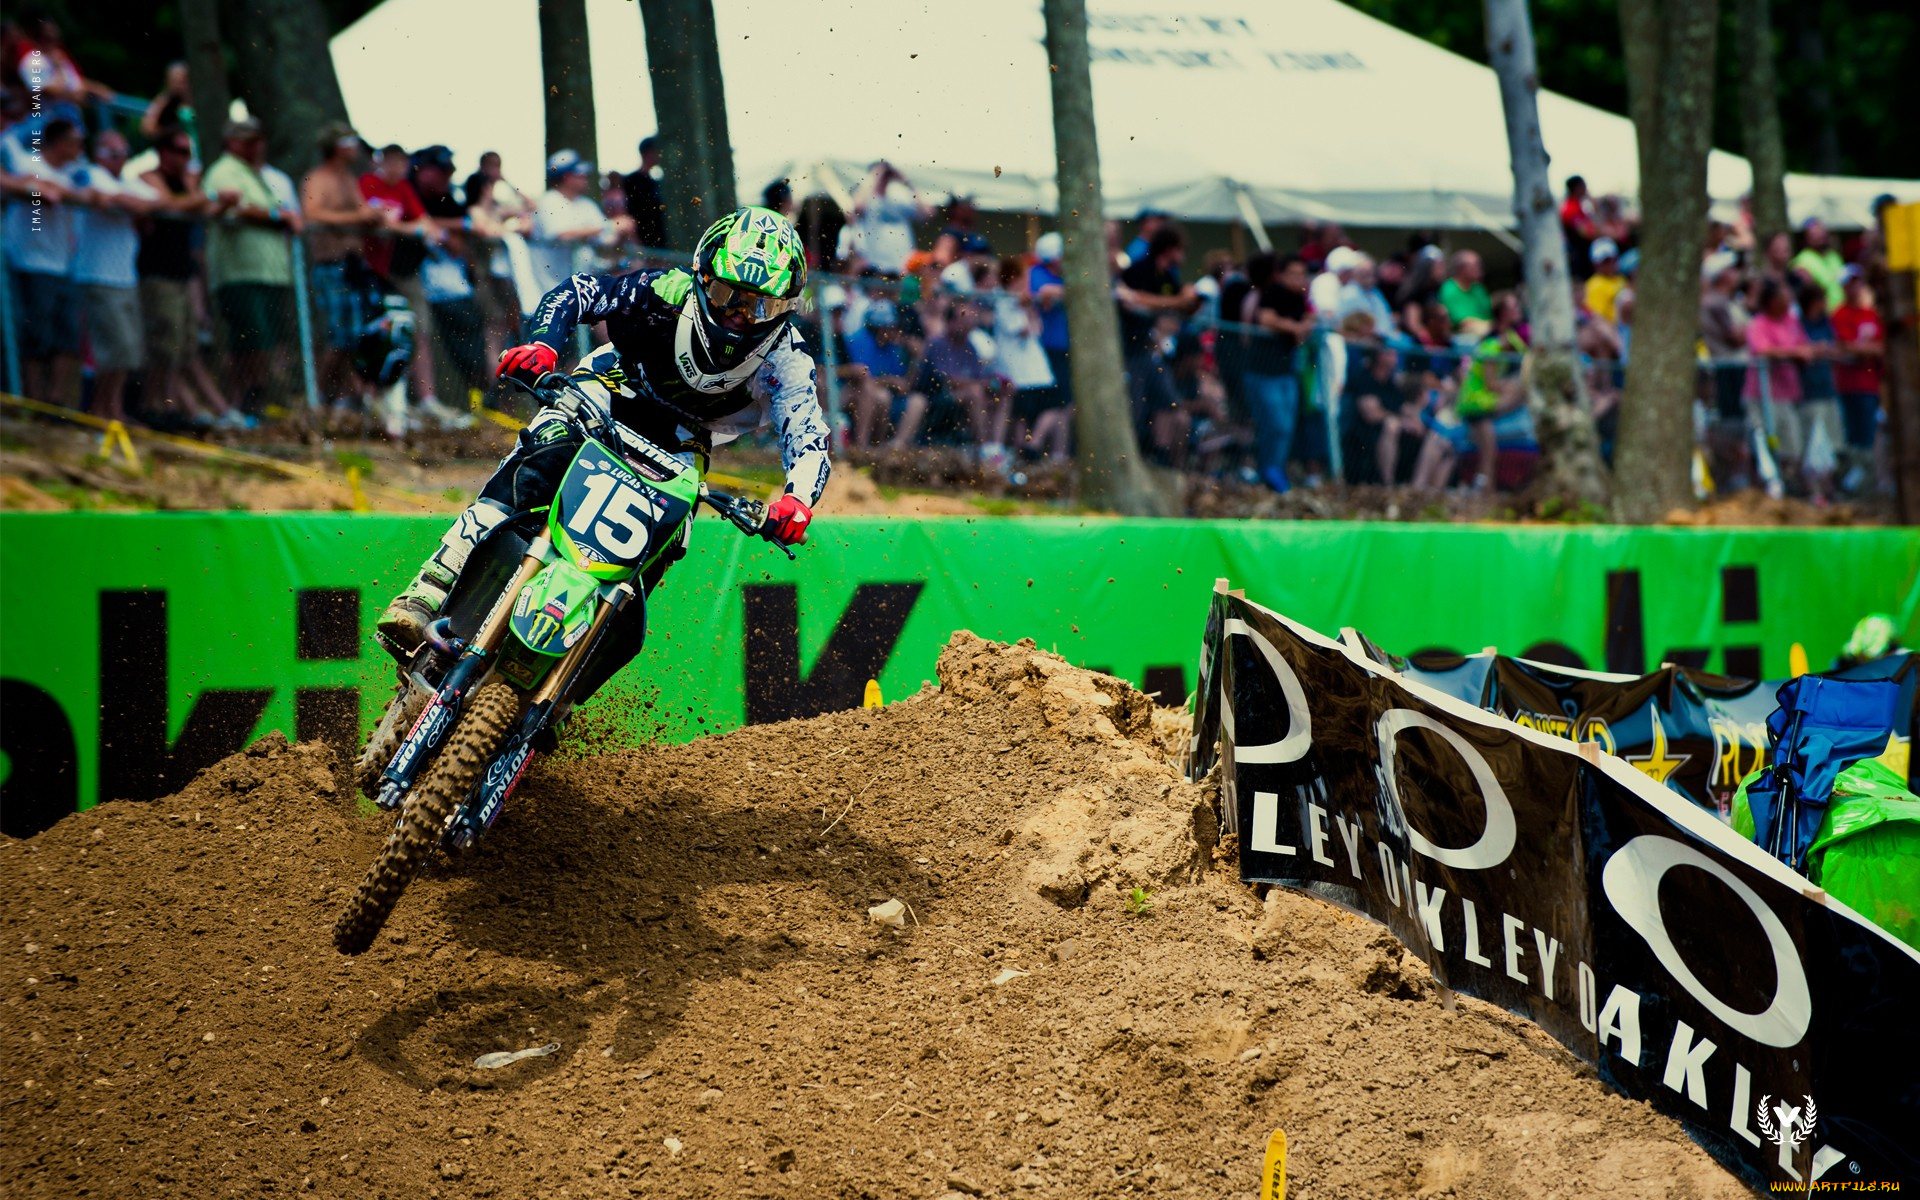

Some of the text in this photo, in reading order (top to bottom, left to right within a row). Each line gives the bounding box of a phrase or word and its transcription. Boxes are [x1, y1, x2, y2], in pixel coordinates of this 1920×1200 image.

[540, 289, 573, 326] MONSTER
[679, 352, 697, 379] VANS
[614, 425, 686, 475] RENTHA
[610, 467, 641, 488] LUCAS
[567, 472, 665, 559] 15
[475, 564, 523, 642] PRO CIRCUIT
[479, 742, 529, 825] DUNLOP
